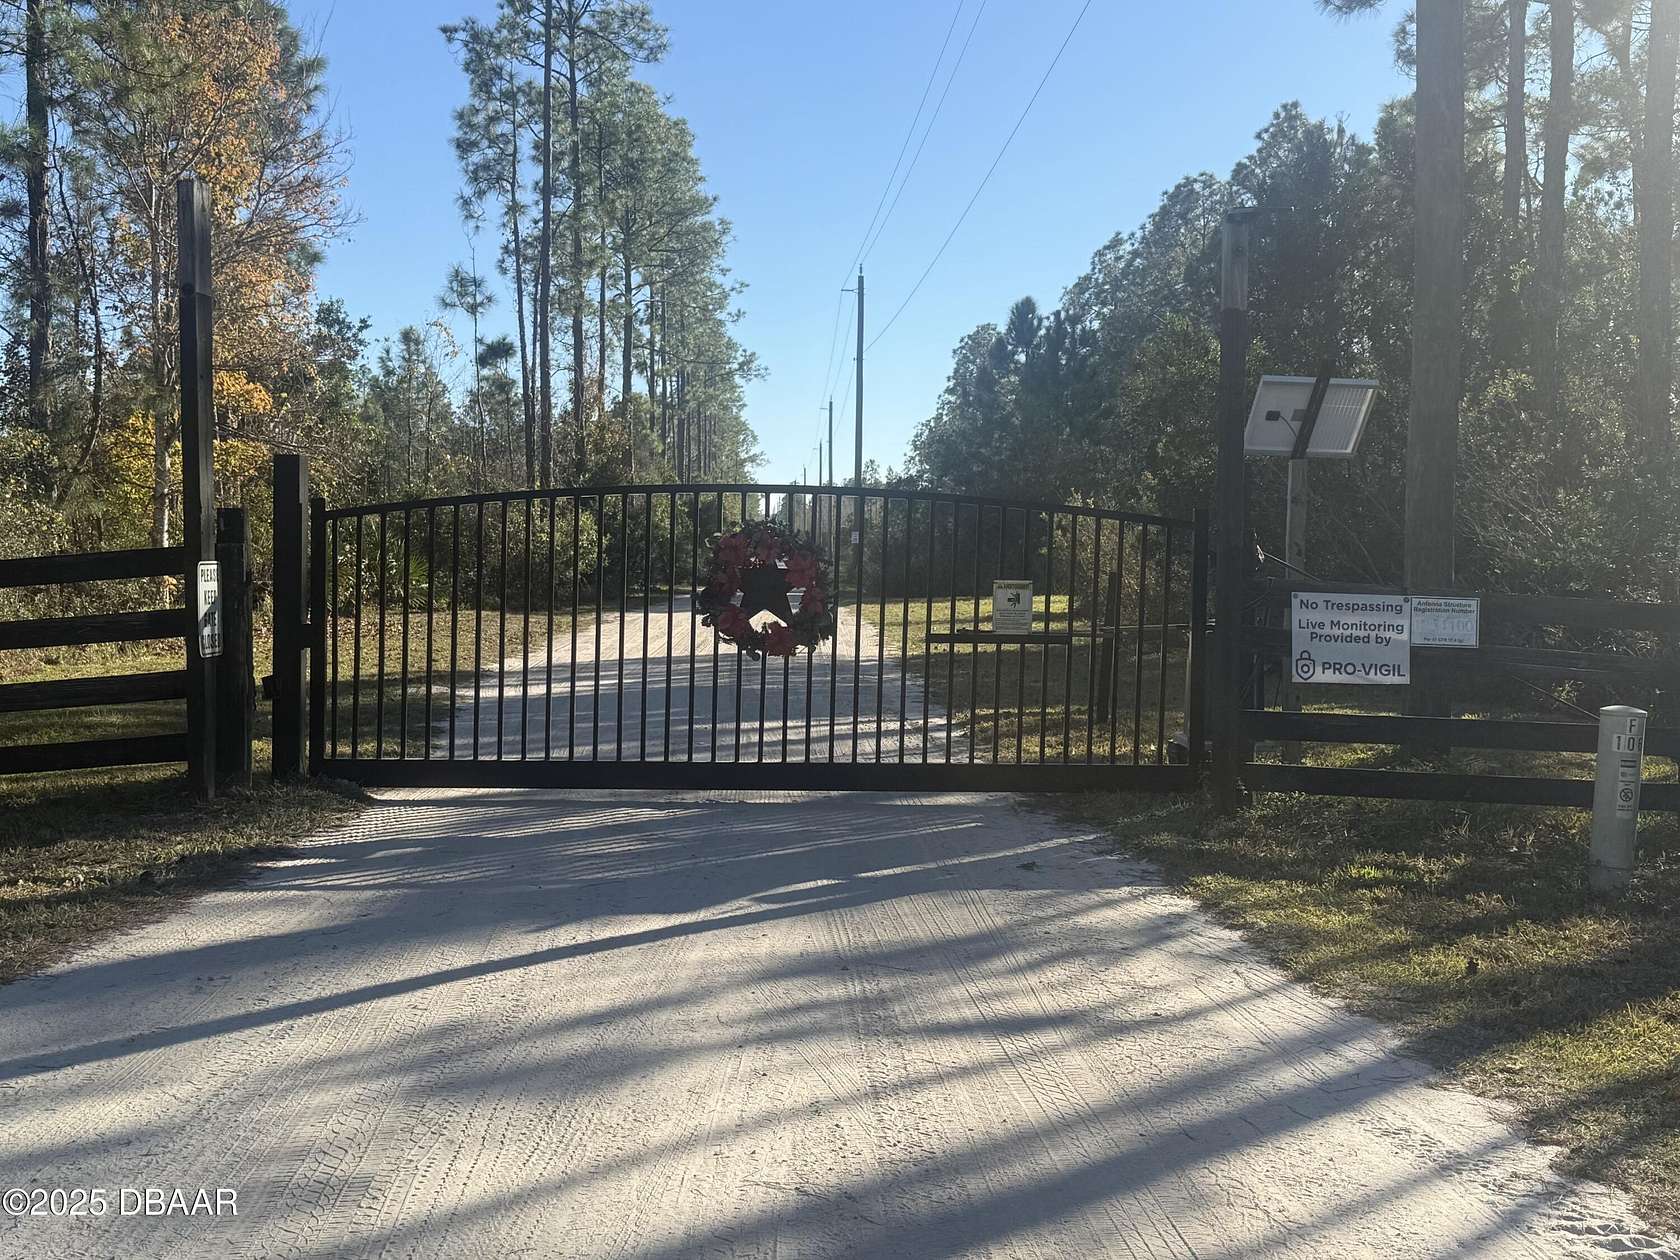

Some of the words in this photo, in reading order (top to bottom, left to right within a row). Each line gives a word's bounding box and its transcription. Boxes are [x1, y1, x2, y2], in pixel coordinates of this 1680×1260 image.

[1299, 599, 1318, 610] No
[1323, 600, 1403, 614] Trespassing
[1298, 618, 1325, 630] Live
[1330, 619, 1404, 634] Monitoring
[1310, 631, 1370, 644] Provided
[1375, 633, 1391, 646] by
[1322, 661, 1406, 677] PRO-VIGIL
[1628, 718, 1637, 733] F
